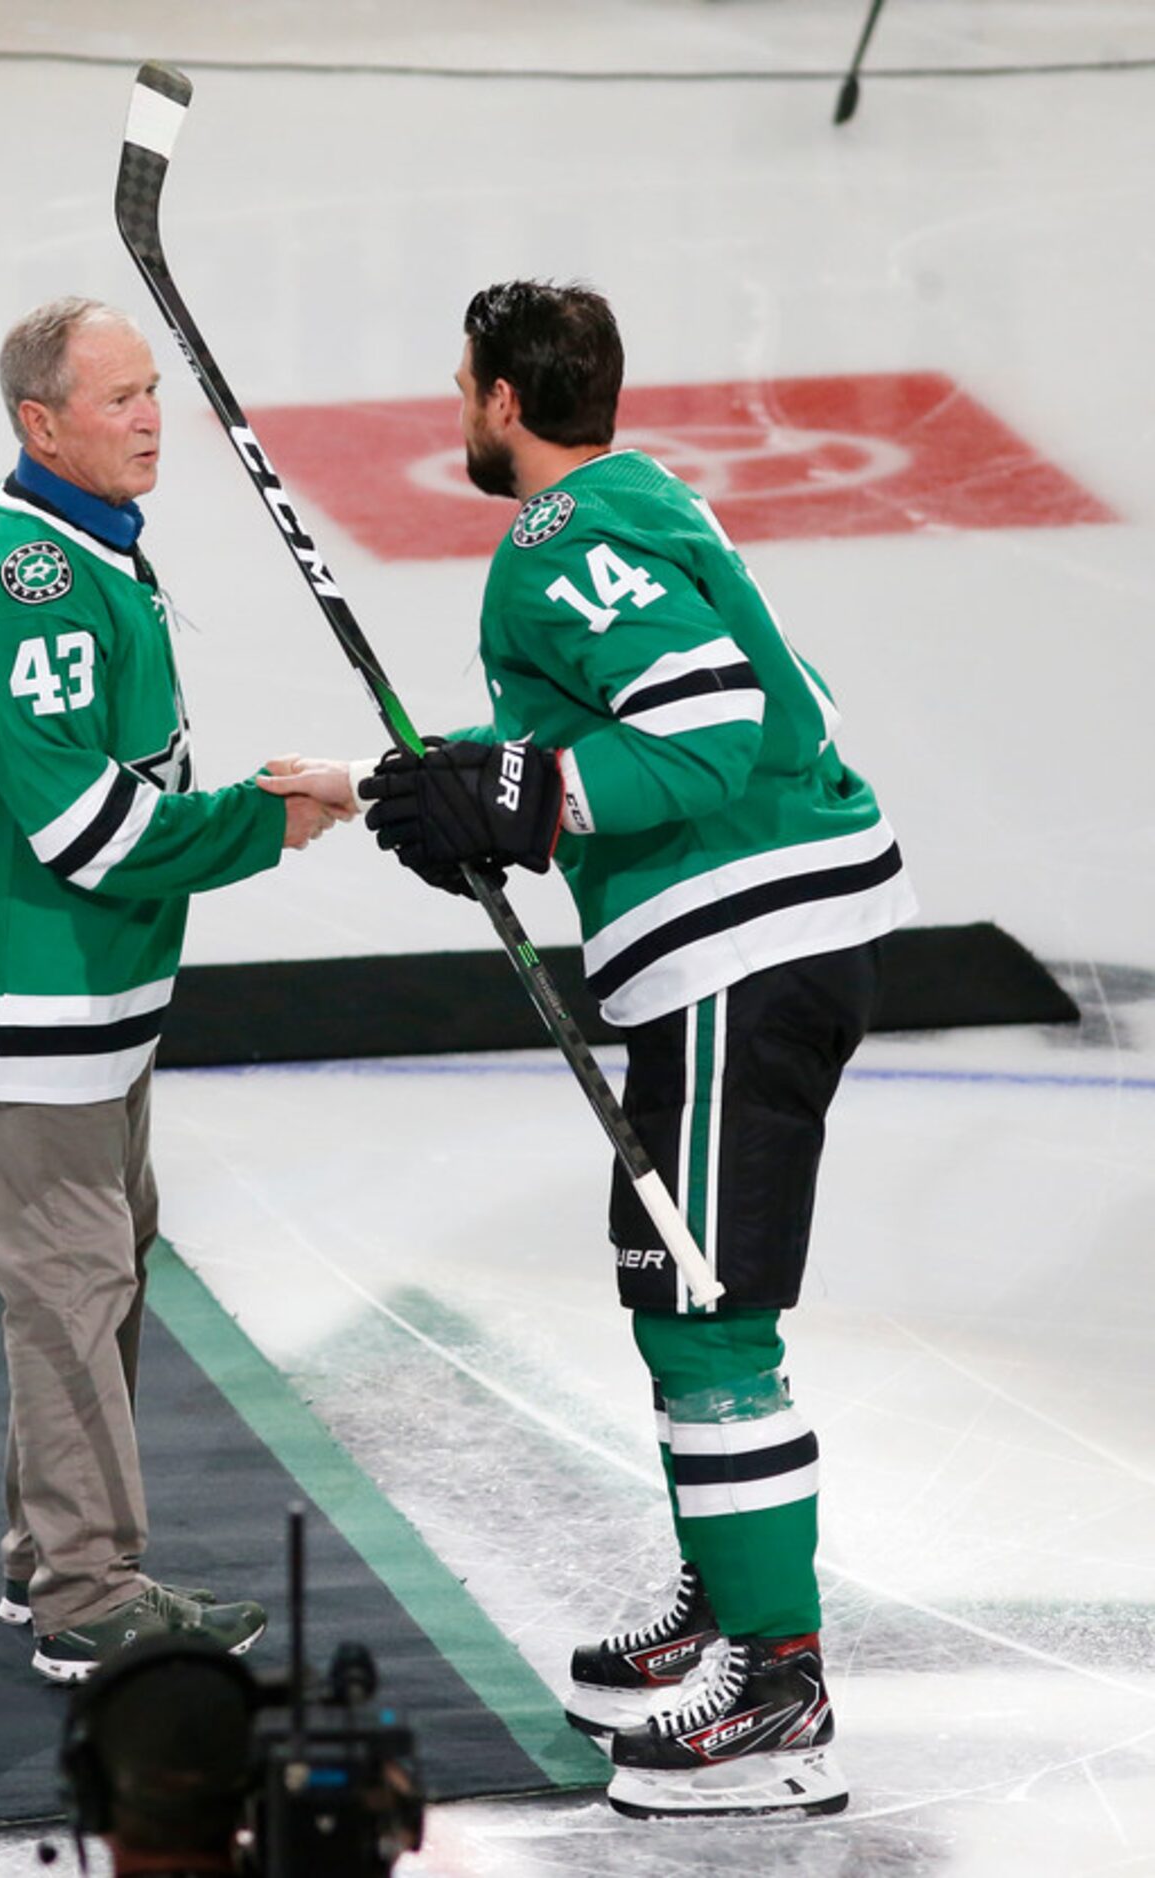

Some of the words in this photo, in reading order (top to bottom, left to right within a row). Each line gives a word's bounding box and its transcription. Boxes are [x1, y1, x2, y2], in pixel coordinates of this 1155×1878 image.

[230, 422, 344, 598] CCM
[544, 541, 668, 634] 14
[10, 631, 95, 716] 43
[647, 1641, 696, 1669] CCM
[701, 1716, 754, 1749] CCM
